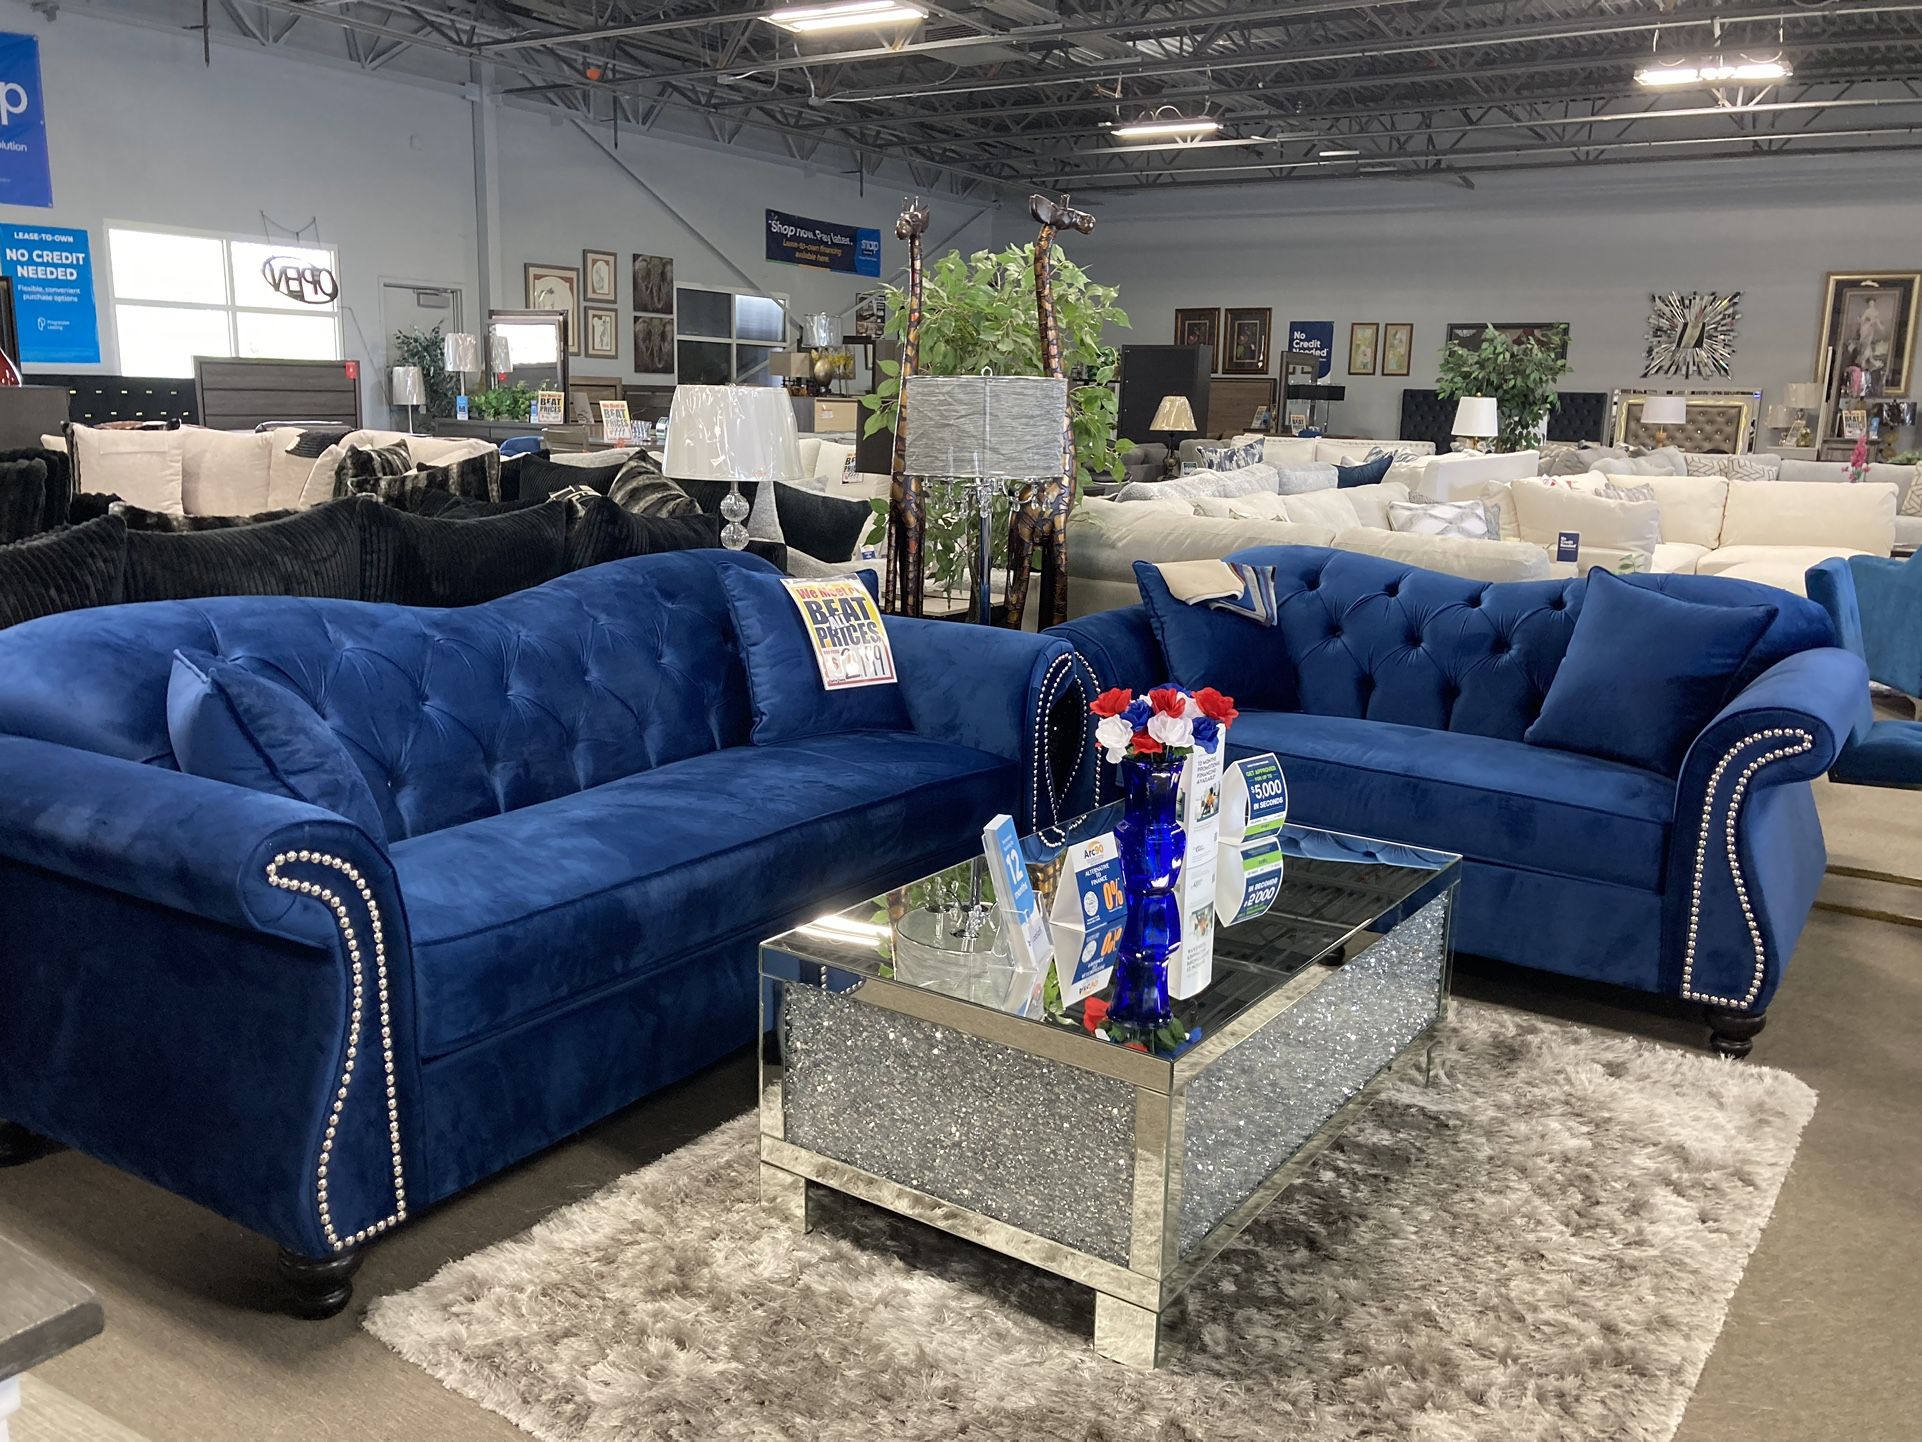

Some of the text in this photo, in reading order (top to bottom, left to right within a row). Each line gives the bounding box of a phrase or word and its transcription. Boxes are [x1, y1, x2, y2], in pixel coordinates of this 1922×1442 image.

[14, 231, 74, 243] LEASE-TO-OWN
[771, 220, 796, 238] Shop
[816, 230, 831, 244] Pay
[861, 239, 879, 254] snap
[5, 248, 85, 265] NO CREDIT
[16, 265, 78, 280] NEEDED
[23, 293, 78, 303] purchase options
[45, 286, 80, 295] convenient
[1293, 331, 1305, 340] No
[1293, 340, 1320, 349] Credit
[796, 588, 818, 599] We
[803, 596, 870, 625] BEAT
[828, 614, 850, 630] ALL
[815, 621, 882, 649] PRICES
[1255, 765, 1276, 776] APPROVED
[1251, 779, 1282, 800] $5,000
[1253, 797, 1283, 810] IN SECONDS
[1084, 844, 1104, 859] Arc90
[1006, 849, 1024, 885] 12
[1085, 863, 1110, 877] ALTERNATIVE
[1091, 875, 1108, 886] FINANCE
[1014, 883, 1028, 899] months
